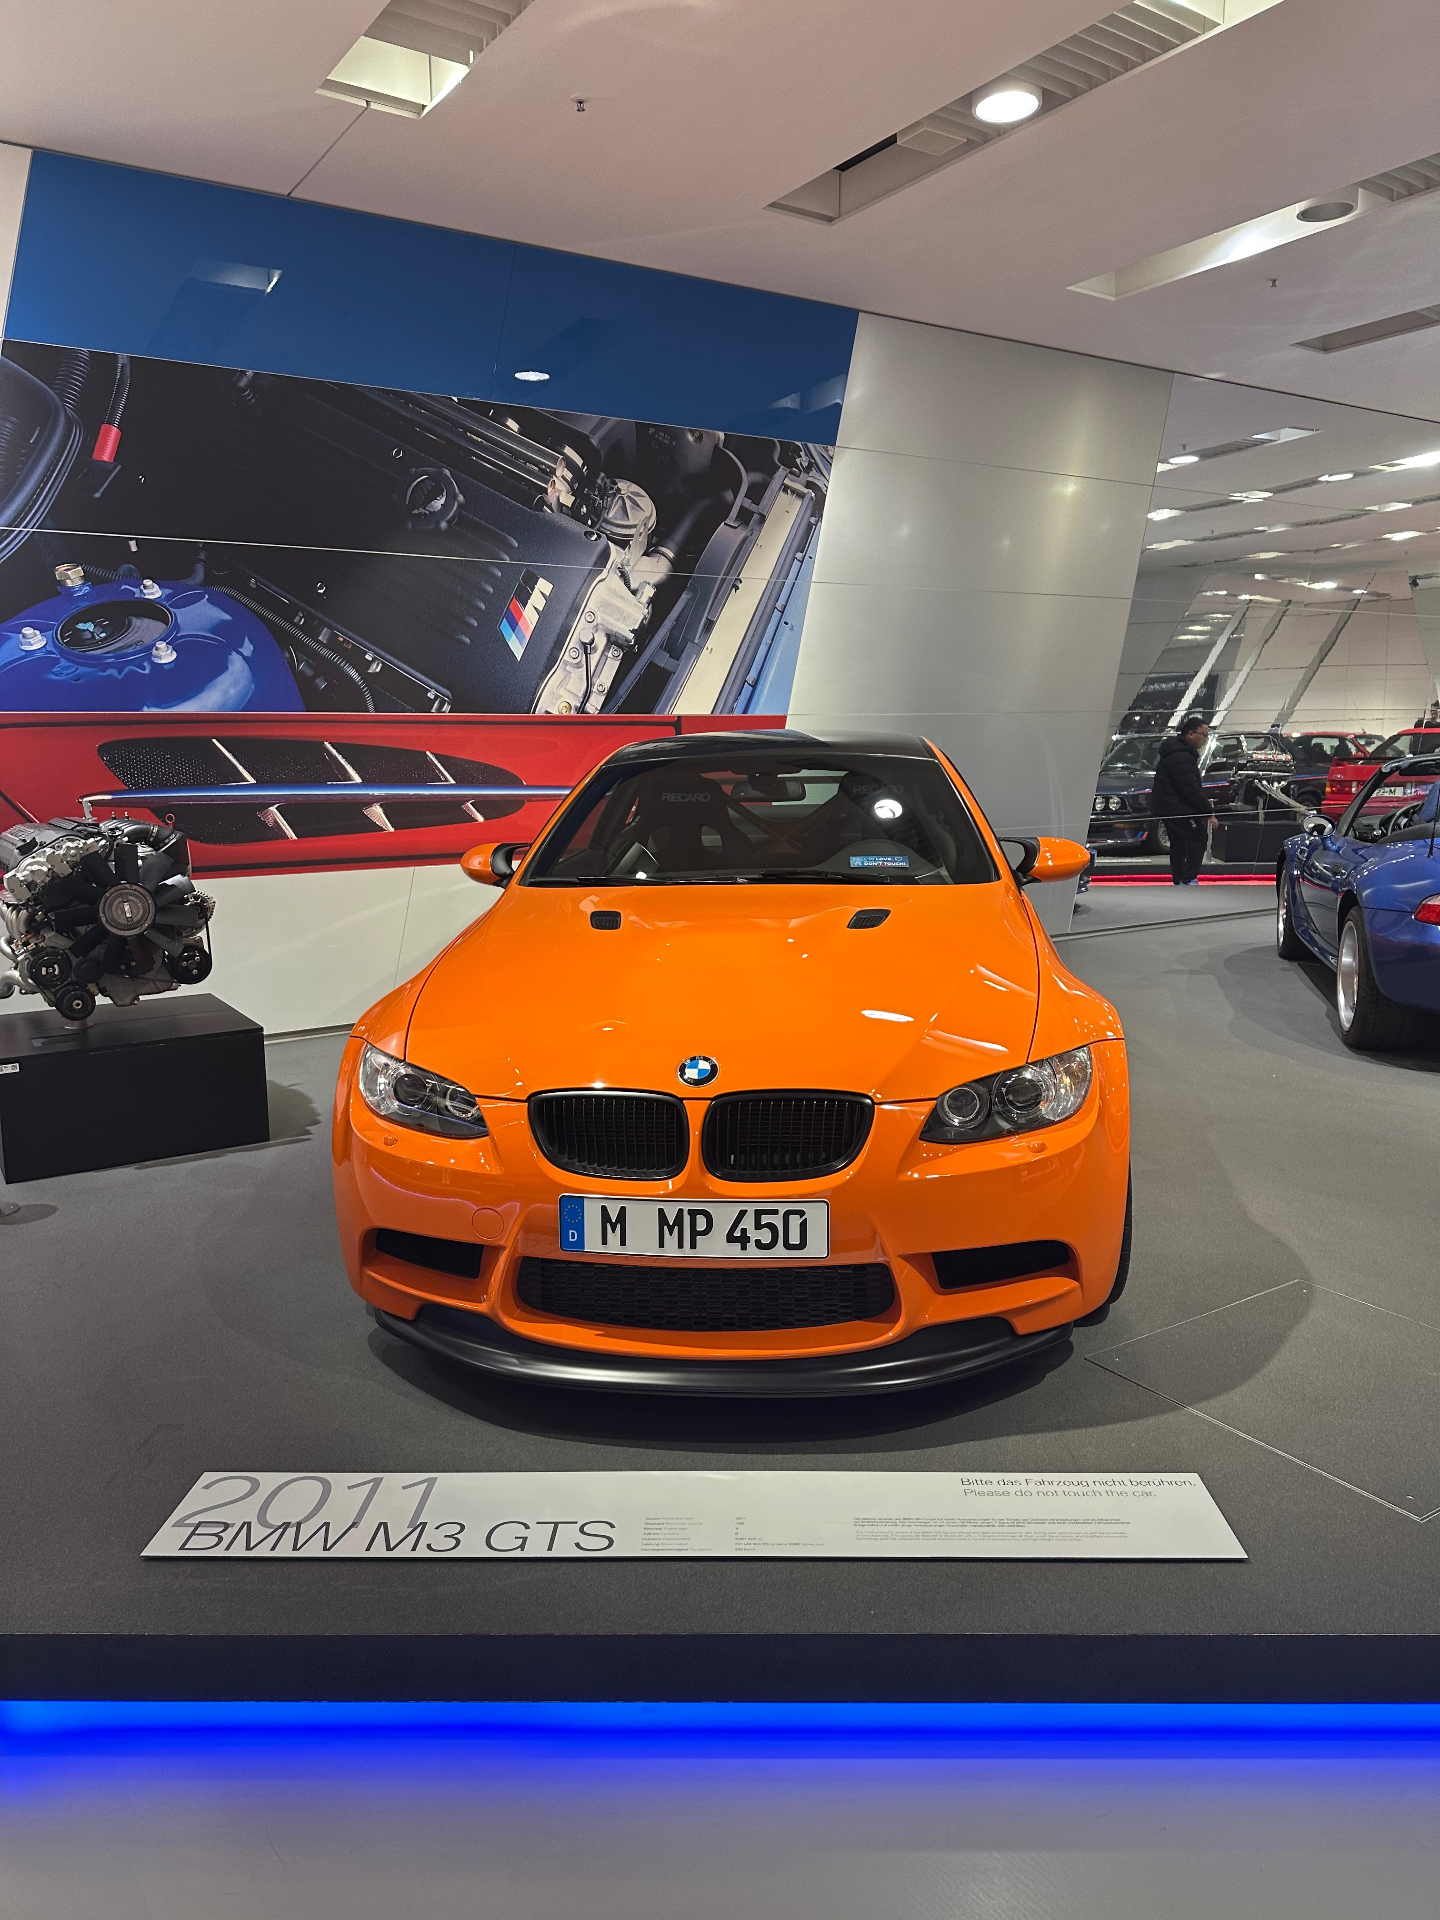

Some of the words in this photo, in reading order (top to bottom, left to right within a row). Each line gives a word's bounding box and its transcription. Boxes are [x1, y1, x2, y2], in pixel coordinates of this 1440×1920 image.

[661, 792, 710, 803] RECARO
[568, 1230, 578, 1242] D
[600, 1204, 627, 1247] M
[658, 1207, 714, 1250] MP
[726, 1208, 808, 1251] 450
[960, 1477, 993, 1486] Bitte
[997, 1477, 1022, 1486] das
[1025, 1478, 1090, 1488] Fahrzeug
[1093, 1478, 1127, 1487] nicht
[1129, 1478, 1197, 1487] berühren.
[963, 1488, 1011, 1497] Please
[1014, 1488, 1033, 1497] do
[1036, 1488, 1059, 1497] not
[1063, 1488, 1102, 1497] touch
[1105, 1488, 1129, 1497] the
[1132, 1489, 1157, 1497] car.
[172, 1475, 439, 1529] 2011
[177, 1520, 358, 1553] BMW
[364, 1519, 466, 1553] M3
[484, 1519, 617, 1553] GTS
